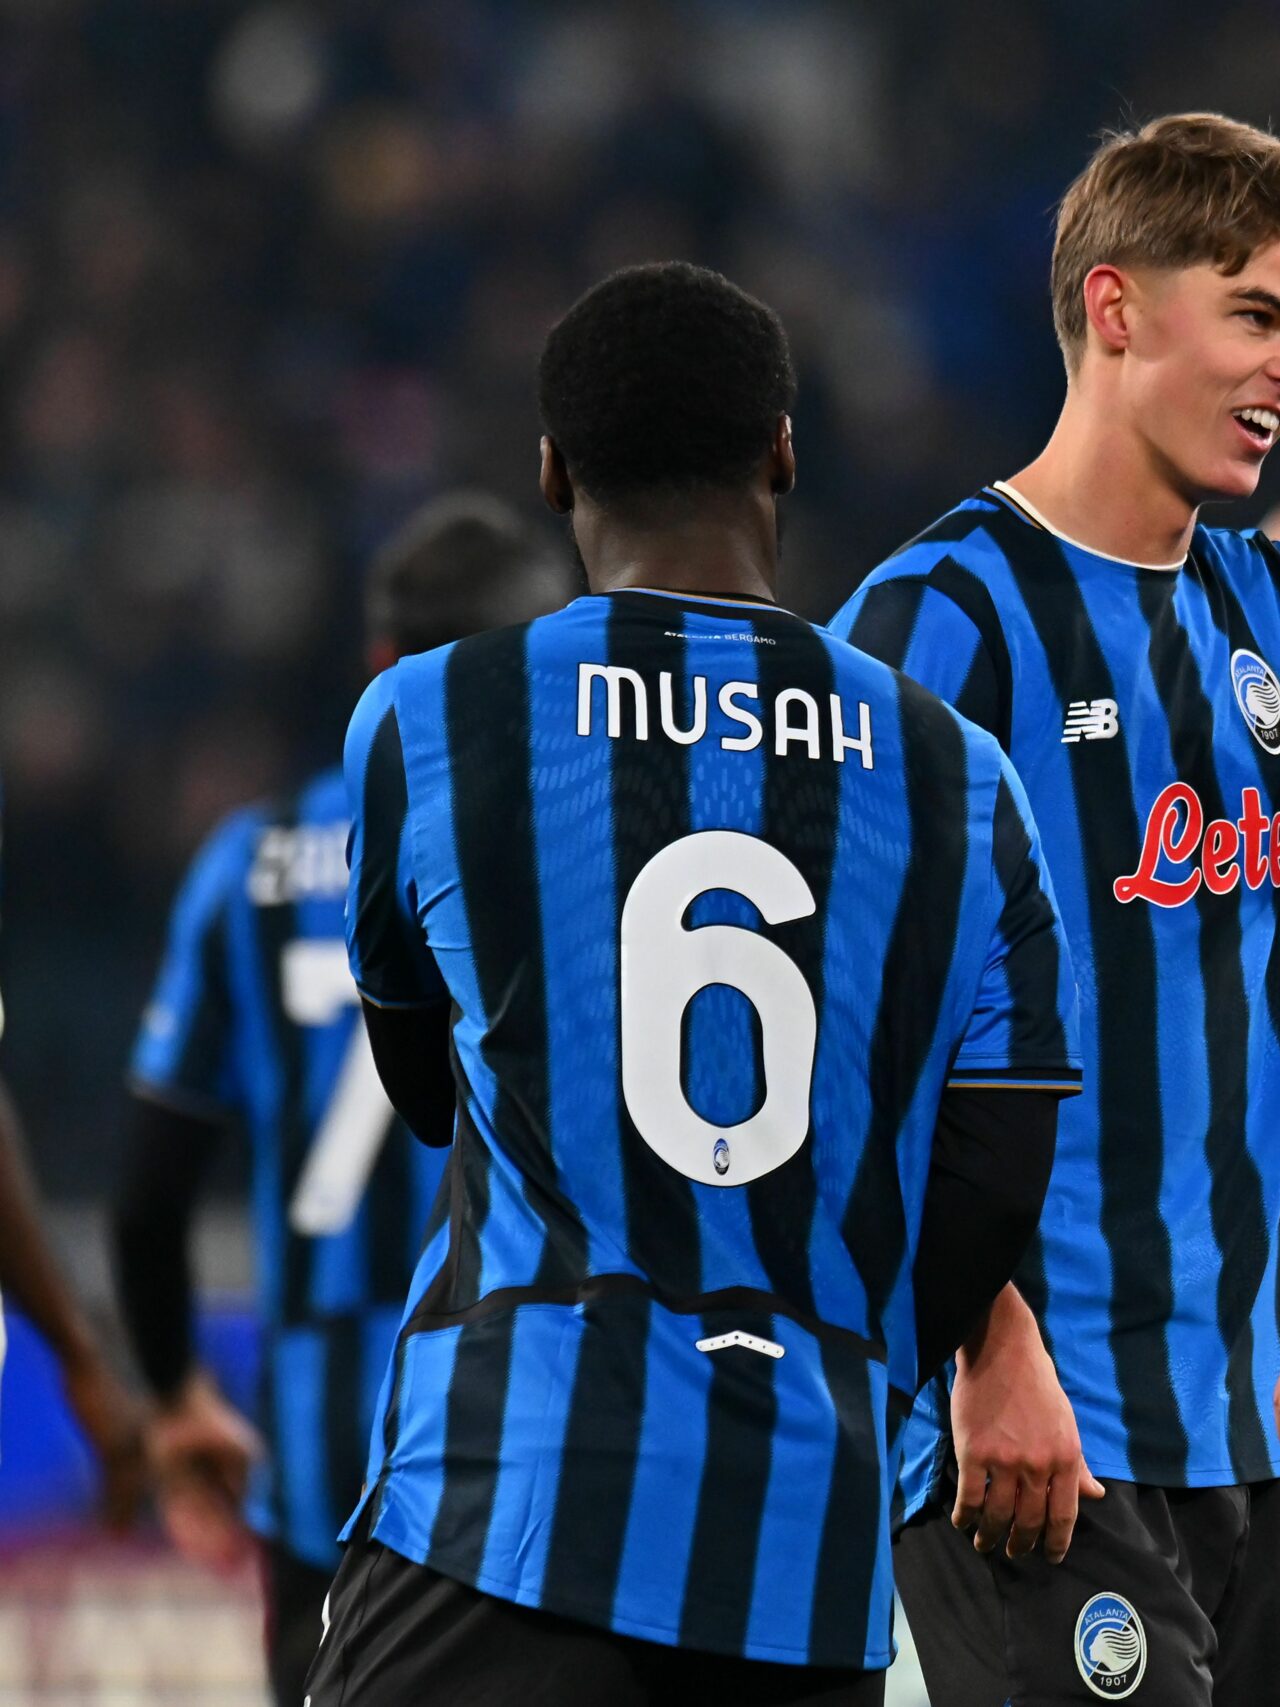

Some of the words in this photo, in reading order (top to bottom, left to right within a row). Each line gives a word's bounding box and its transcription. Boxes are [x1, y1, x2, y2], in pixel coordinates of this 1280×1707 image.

[724, 633, 776, 645] BERGAMO
[577, 662, 874, 770] MUSAH
[1261, 728, 1279, 740] 1907
[620, 830, 817, 1187] 6
[1085, 1608, 1129, 1625] ATALANTA
[1100, 1674, 1127, 1687] 1907
